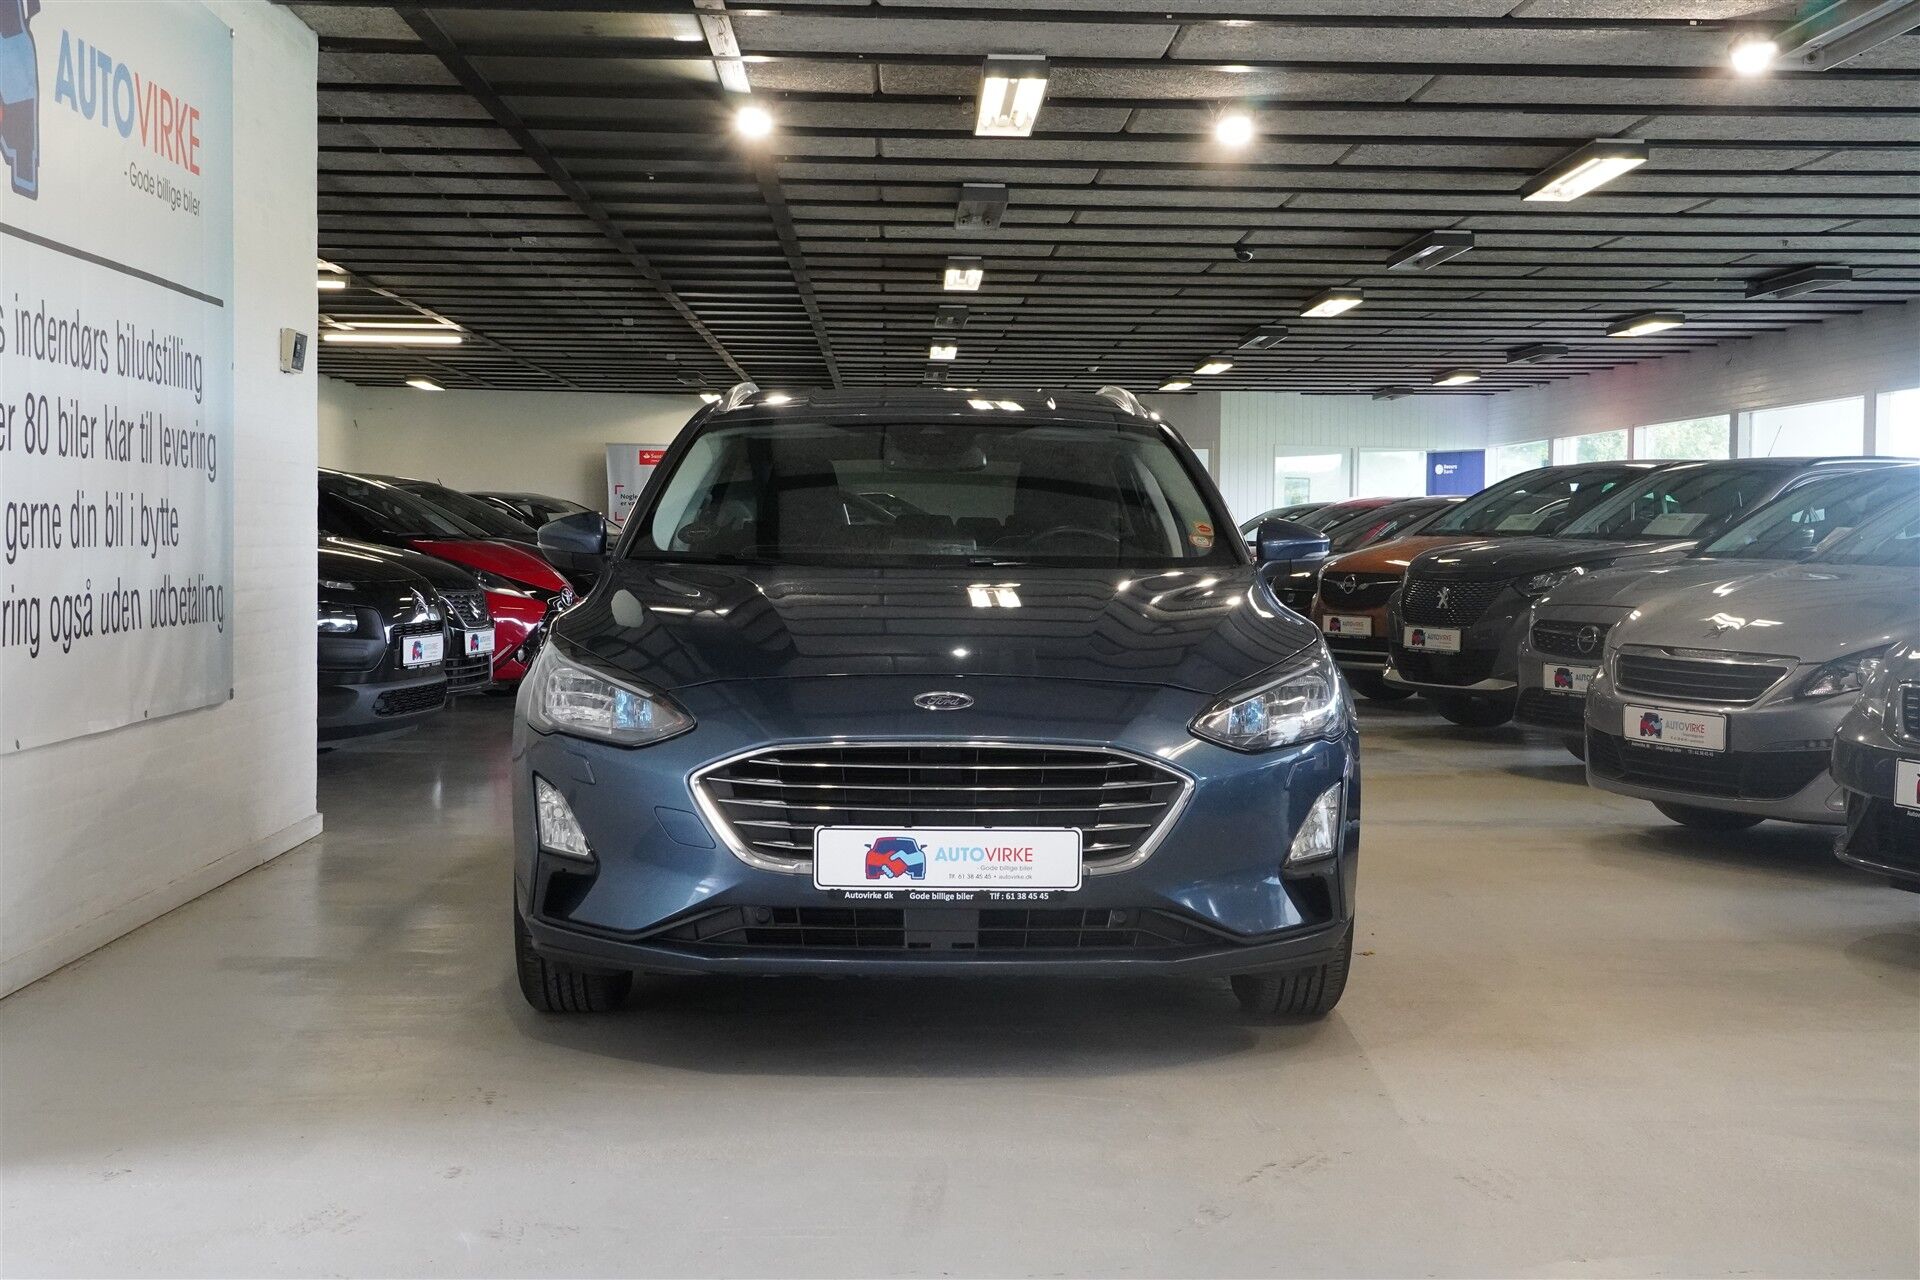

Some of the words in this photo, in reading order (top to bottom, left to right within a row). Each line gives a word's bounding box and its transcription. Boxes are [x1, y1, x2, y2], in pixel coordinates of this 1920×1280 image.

[55, 29, 200, 176] AUTOVIRKE
[130, 161, 155, 195] Gode
[157, 174, 181, 211] billige
[183, 187, 200, 216] biler
[15, 293, 109, 374] indendørs
[116, 320, 202, 404] biludstilling
[25, 392, 49, 455] 80
[58, 396, 97, 459] biler
[104, 404, 134, 462] klar
[140, 411, 153, 464] til
[160, 413, 216, 482] levering
[6, 502, 62, 564] gerne
[70, 490, 97, 548] din
[105, 491, 123, 548] bil
[131, 493, 134, 546] i
[141, 493, 179, 559] bytte
[2, 584, 40, 658] ring
[50, 579, 93, 654] også
[101, 577, 142, 635] uden
[150, 574, 223, 633] udbetaling
[927, 695, 959, 705] Ford
[1665, 719, 1705, 734] AUTOVIRKE
[935, 847, 1033, 862] AUTOVIRKE
[844, 891, 882, 899] Autovirke
[884, 891, 894, 899] dk
[909, 892, 930, 900] Gode
[931, 892, 956, 901] billige
[956, 892, 974, 900] biler
